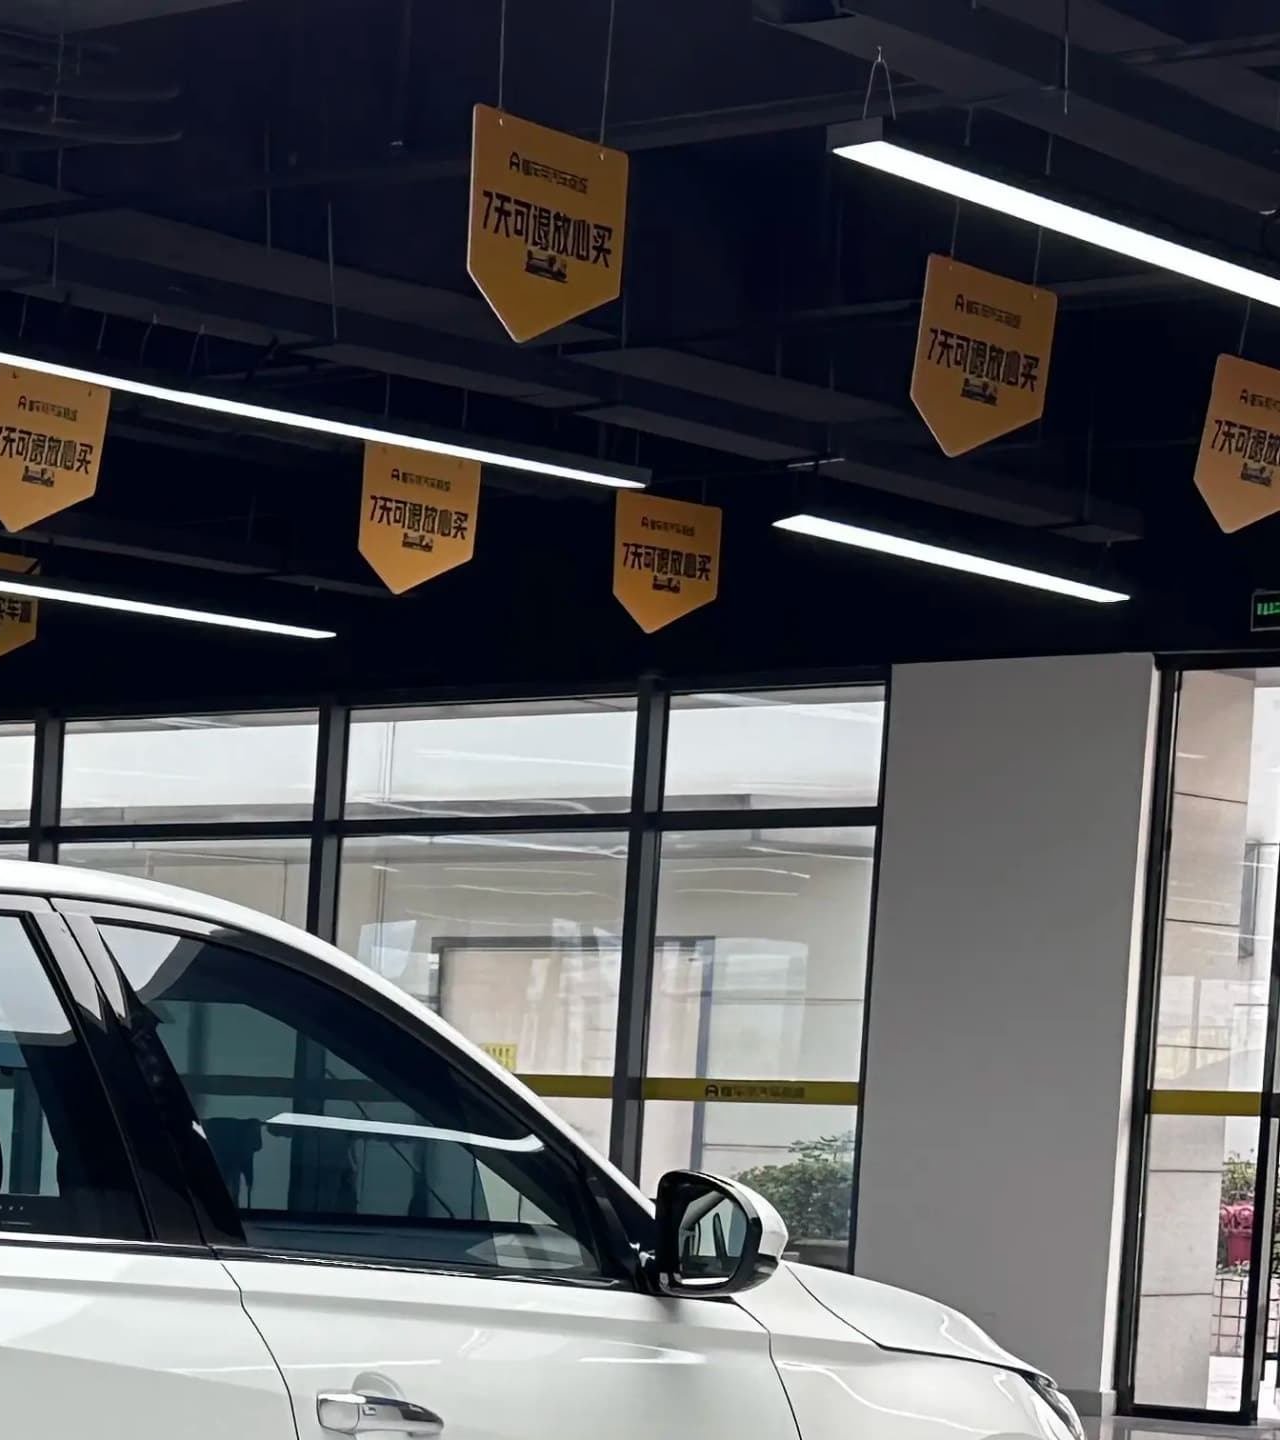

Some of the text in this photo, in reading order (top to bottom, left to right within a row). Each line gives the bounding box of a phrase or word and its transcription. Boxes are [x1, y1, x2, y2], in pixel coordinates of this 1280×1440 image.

[482, 190, 613, 268] 7天可退放心买
[927, 328, 1040, 393] 7天可退放心买
[369, 495, 469, 540] 7天可退放心买
